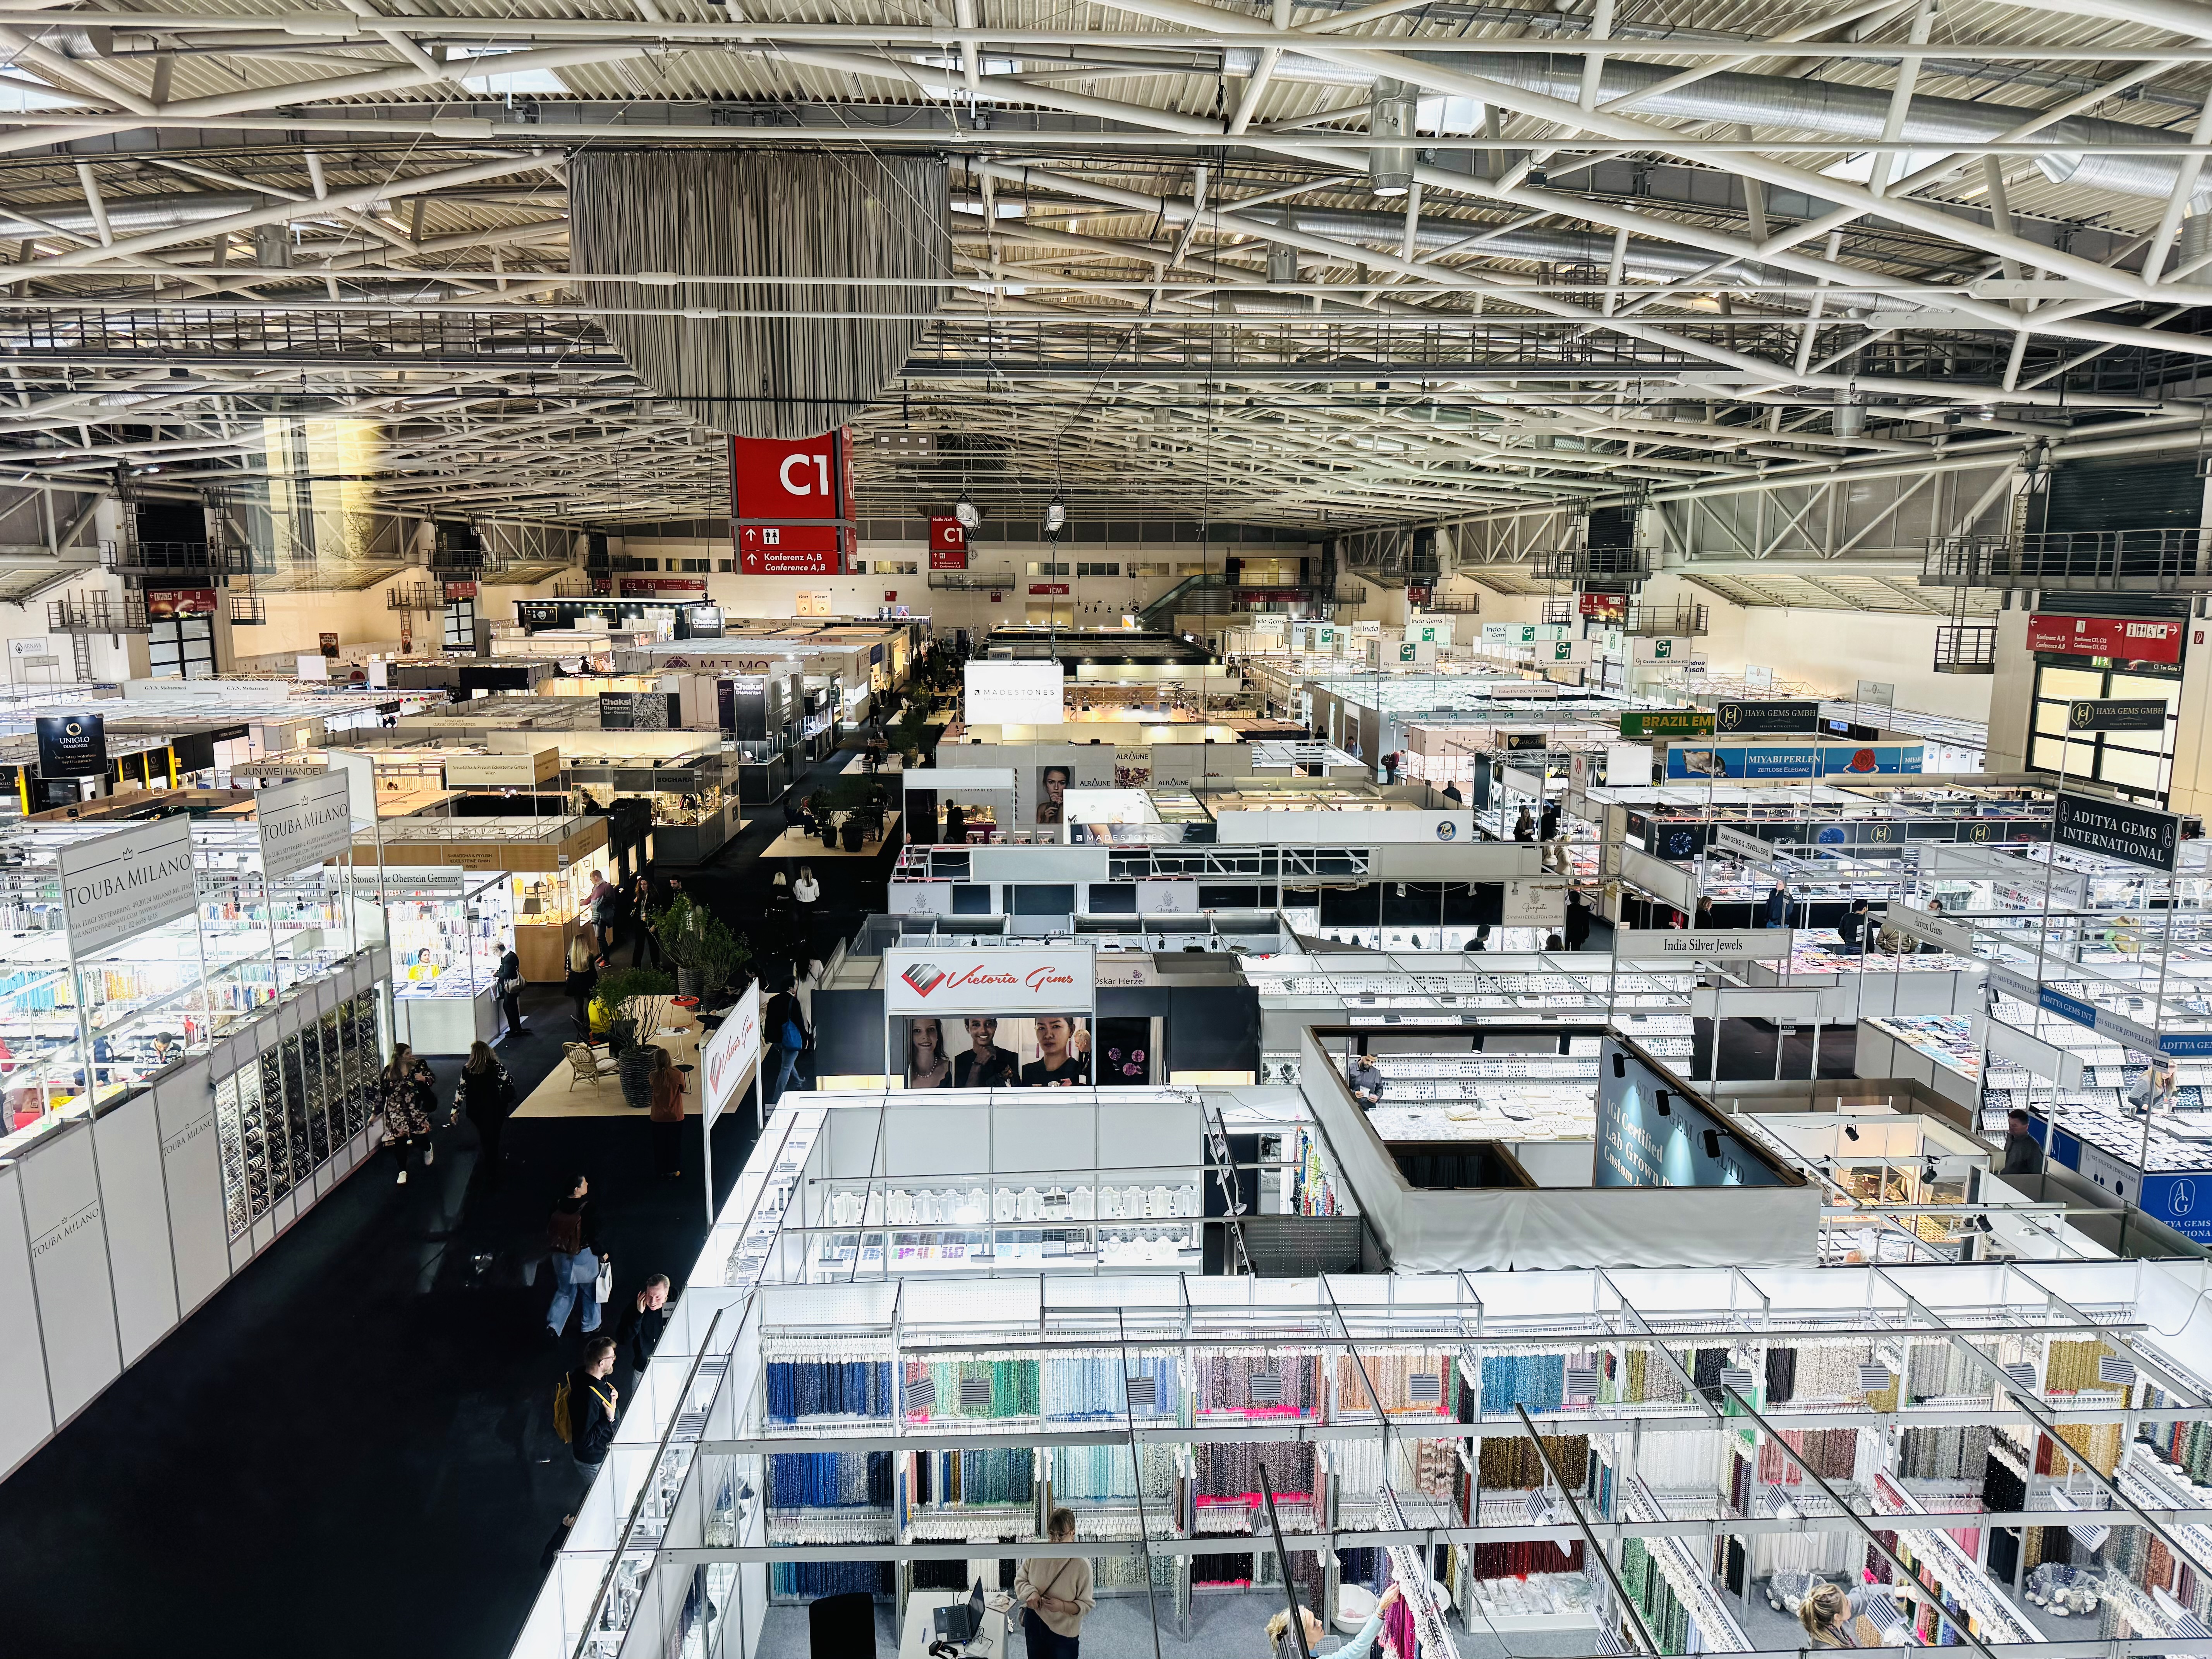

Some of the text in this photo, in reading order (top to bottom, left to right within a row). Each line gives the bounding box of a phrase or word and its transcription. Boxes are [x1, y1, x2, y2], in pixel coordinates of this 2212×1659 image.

[780, 454, 828, 495] C1
[944, 527, 963, 542] C1
[806, 553, 822, 562] A,B
[811, 564, 826, 572] A,B
[1642, 716, 1688, 726] BRAZIL
[262, 804, 347, 841] TOUBA MILANO
[2073, 811, 2156, 840] ADITYA GEMS
[1721, 833, 1730, 841] SAMI
[1730, 837, 1741, 846] GEMS
[1745, 842, 1769, 856] JEWELLERS
[2063, 826, 2164, 862] INTERNATIONAL
[66, 854, 190, 908] TOUBA MILANO
[353, 873, 460, 885] Stones Oberstein Germany
[82, 917, 97, 927] LUIGI
[153, 890, 172, 902] MILANO
[1522, 902, 1547, 913] Ganpati
[1914, 916, 1942, 936] Ariyan Gems
[1664, 938, 1743, 953] India Silver Jewels
[946, 964, 1073, 993] Victoria Gems
[1997, 975, 2013, 987] SILVER
[2041, 994, 2093, 1022] ADITYA GEMS INT.
[2096, 1017, 2104, 1025] 925
[2104, 1019, 2123, 1034] SILVER
[722, 1035, 740, 1074] Victoria
[162, 1118, 213, 1156] TOUBA MILANO
[1607, 1098, 1620, 1123] IGI
[1622, 1113, 1662, 1164] Certified
[1604, 1145, 1632, 1185] Custom
[1605, 1121, 1623, 1151] Lab
[1626, 1142, 1659, 1186] Grown
[2098, 1158, 2112, 1170] SILVER
[2112, 1166, 2137, 1183] JEWELLERY
[32, 1208, 99, 1258] TOUBA MILANO
